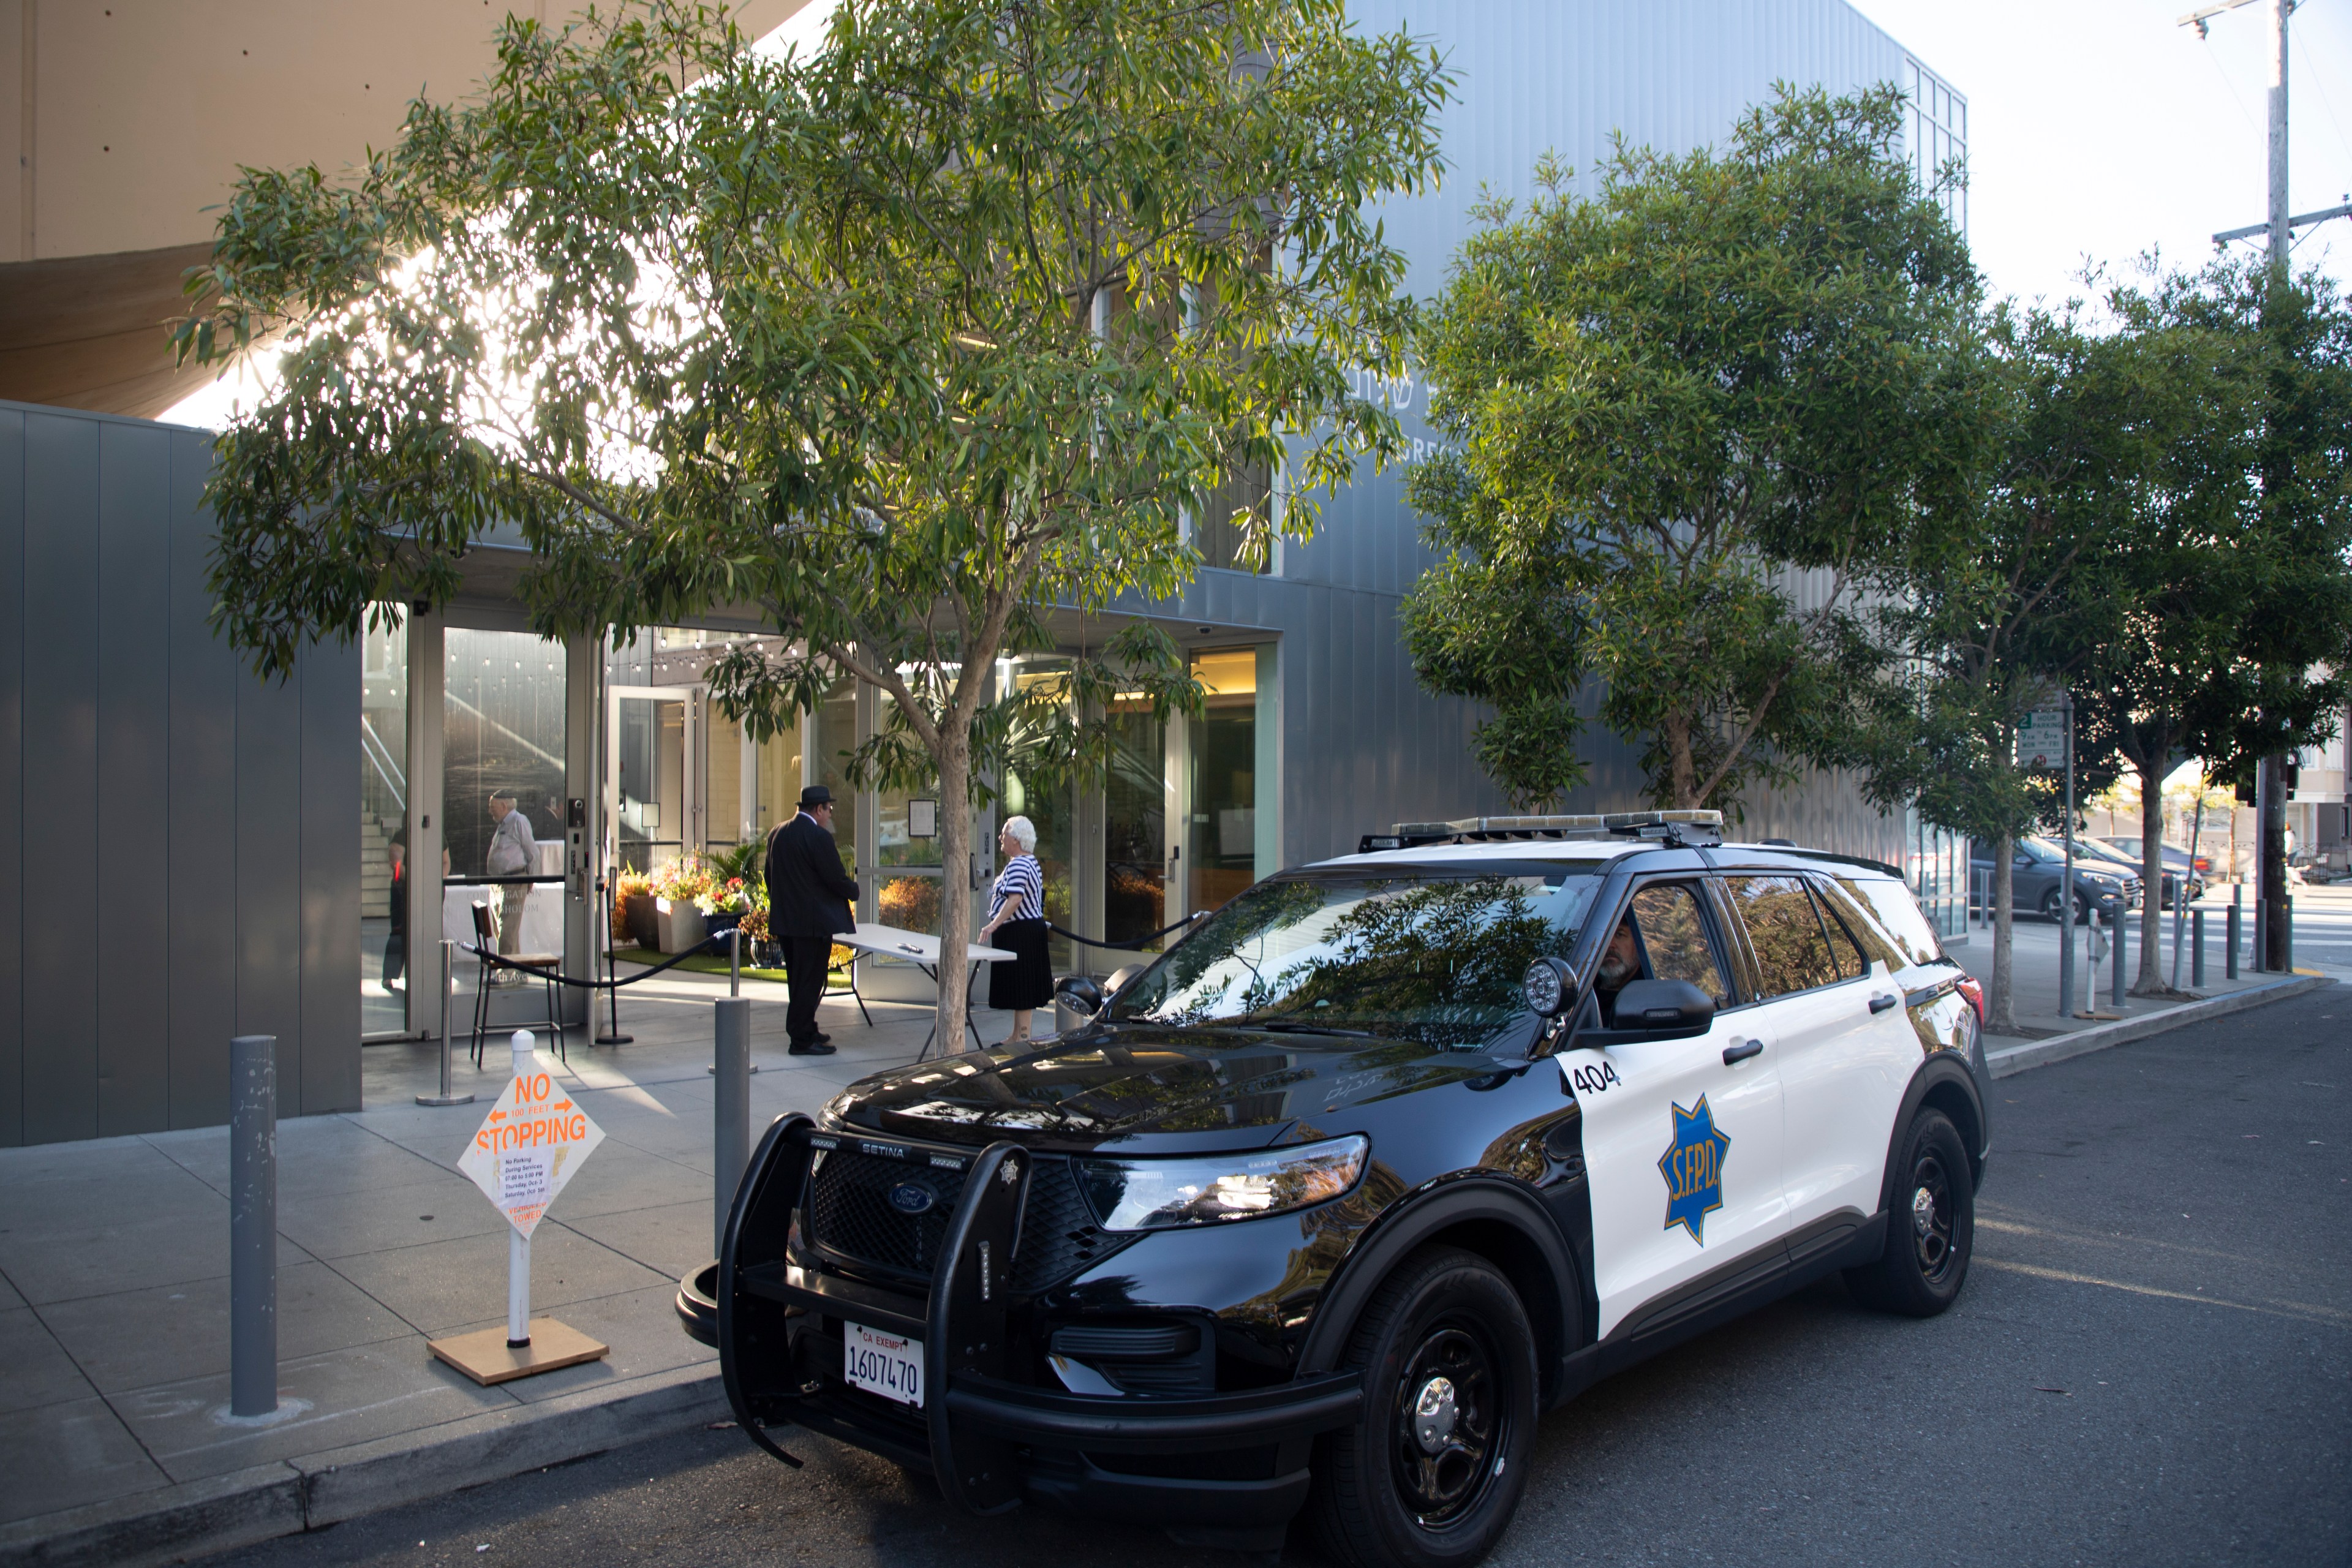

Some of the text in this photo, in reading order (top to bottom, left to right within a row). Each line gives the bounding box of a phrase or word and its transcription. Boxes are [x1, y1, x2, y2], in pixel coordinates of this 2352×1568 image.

[2020, 715, 2029, 727] 2
[1574, 1061, 1621, 1094] 404
[515, 1073, 551, 1104] NO
[511, 1104, 549, 1118] 100 FEET
[477, 1114, 586, 1156] STOPPING
[862, 1144, 904, 1158] SETINA
[896, 1188, 921, 1206] Ford
[513, 1210, 541, 1224] TOWED
[863, 1332, 903, 1352] CA EXEMPT
[850, 1346, 917, 1395] 1607470
